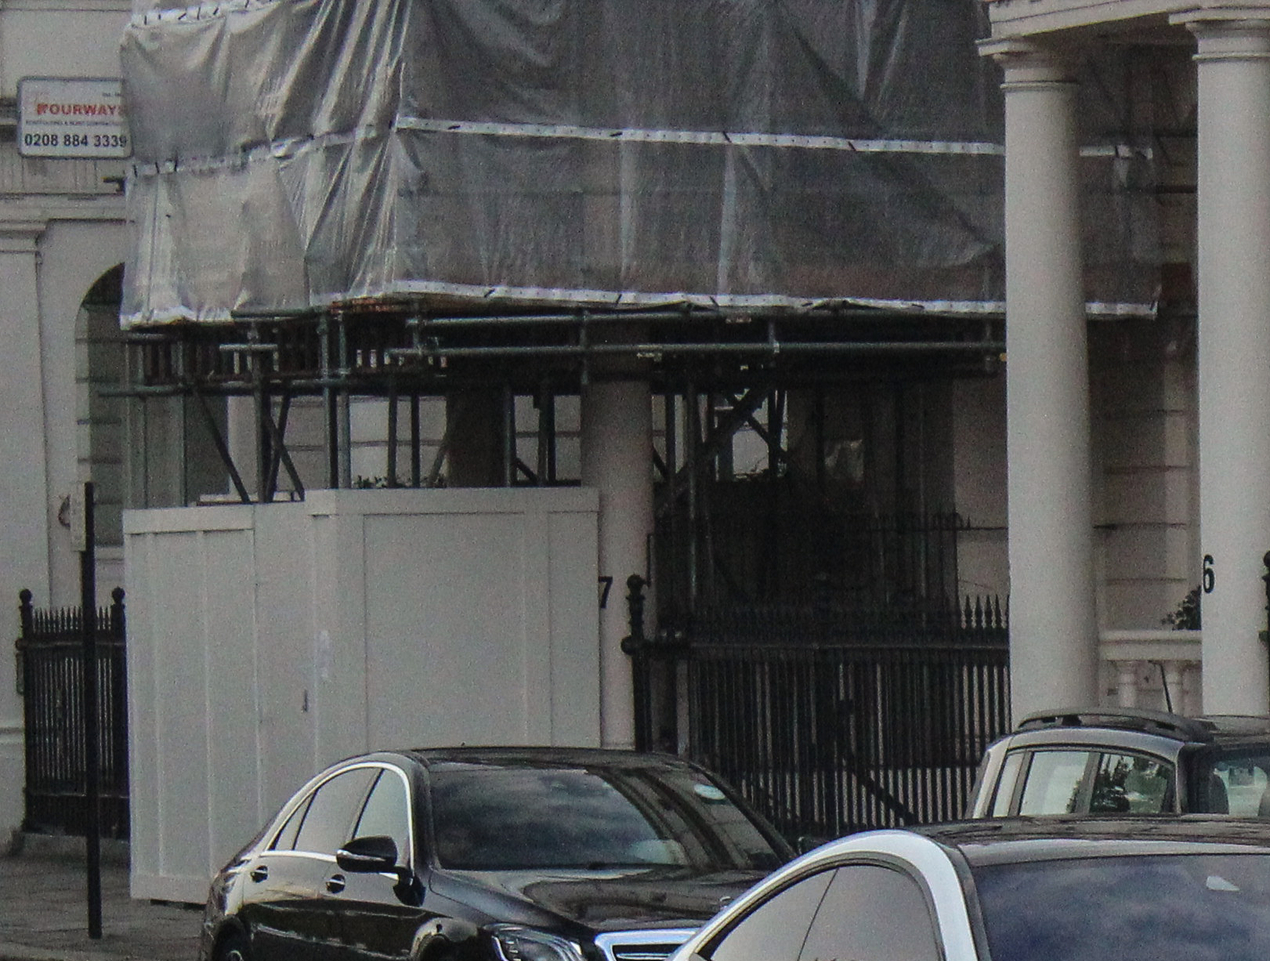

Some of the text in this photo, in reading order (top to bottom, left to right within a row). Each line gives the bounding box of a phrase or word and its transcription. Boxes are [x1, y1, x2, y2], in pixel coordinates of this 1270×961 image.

[24, 134, 127, 148] 0208 884 3339
[1203, 554, 1215, 594] 6
[598, 576, 613, 609] 7
